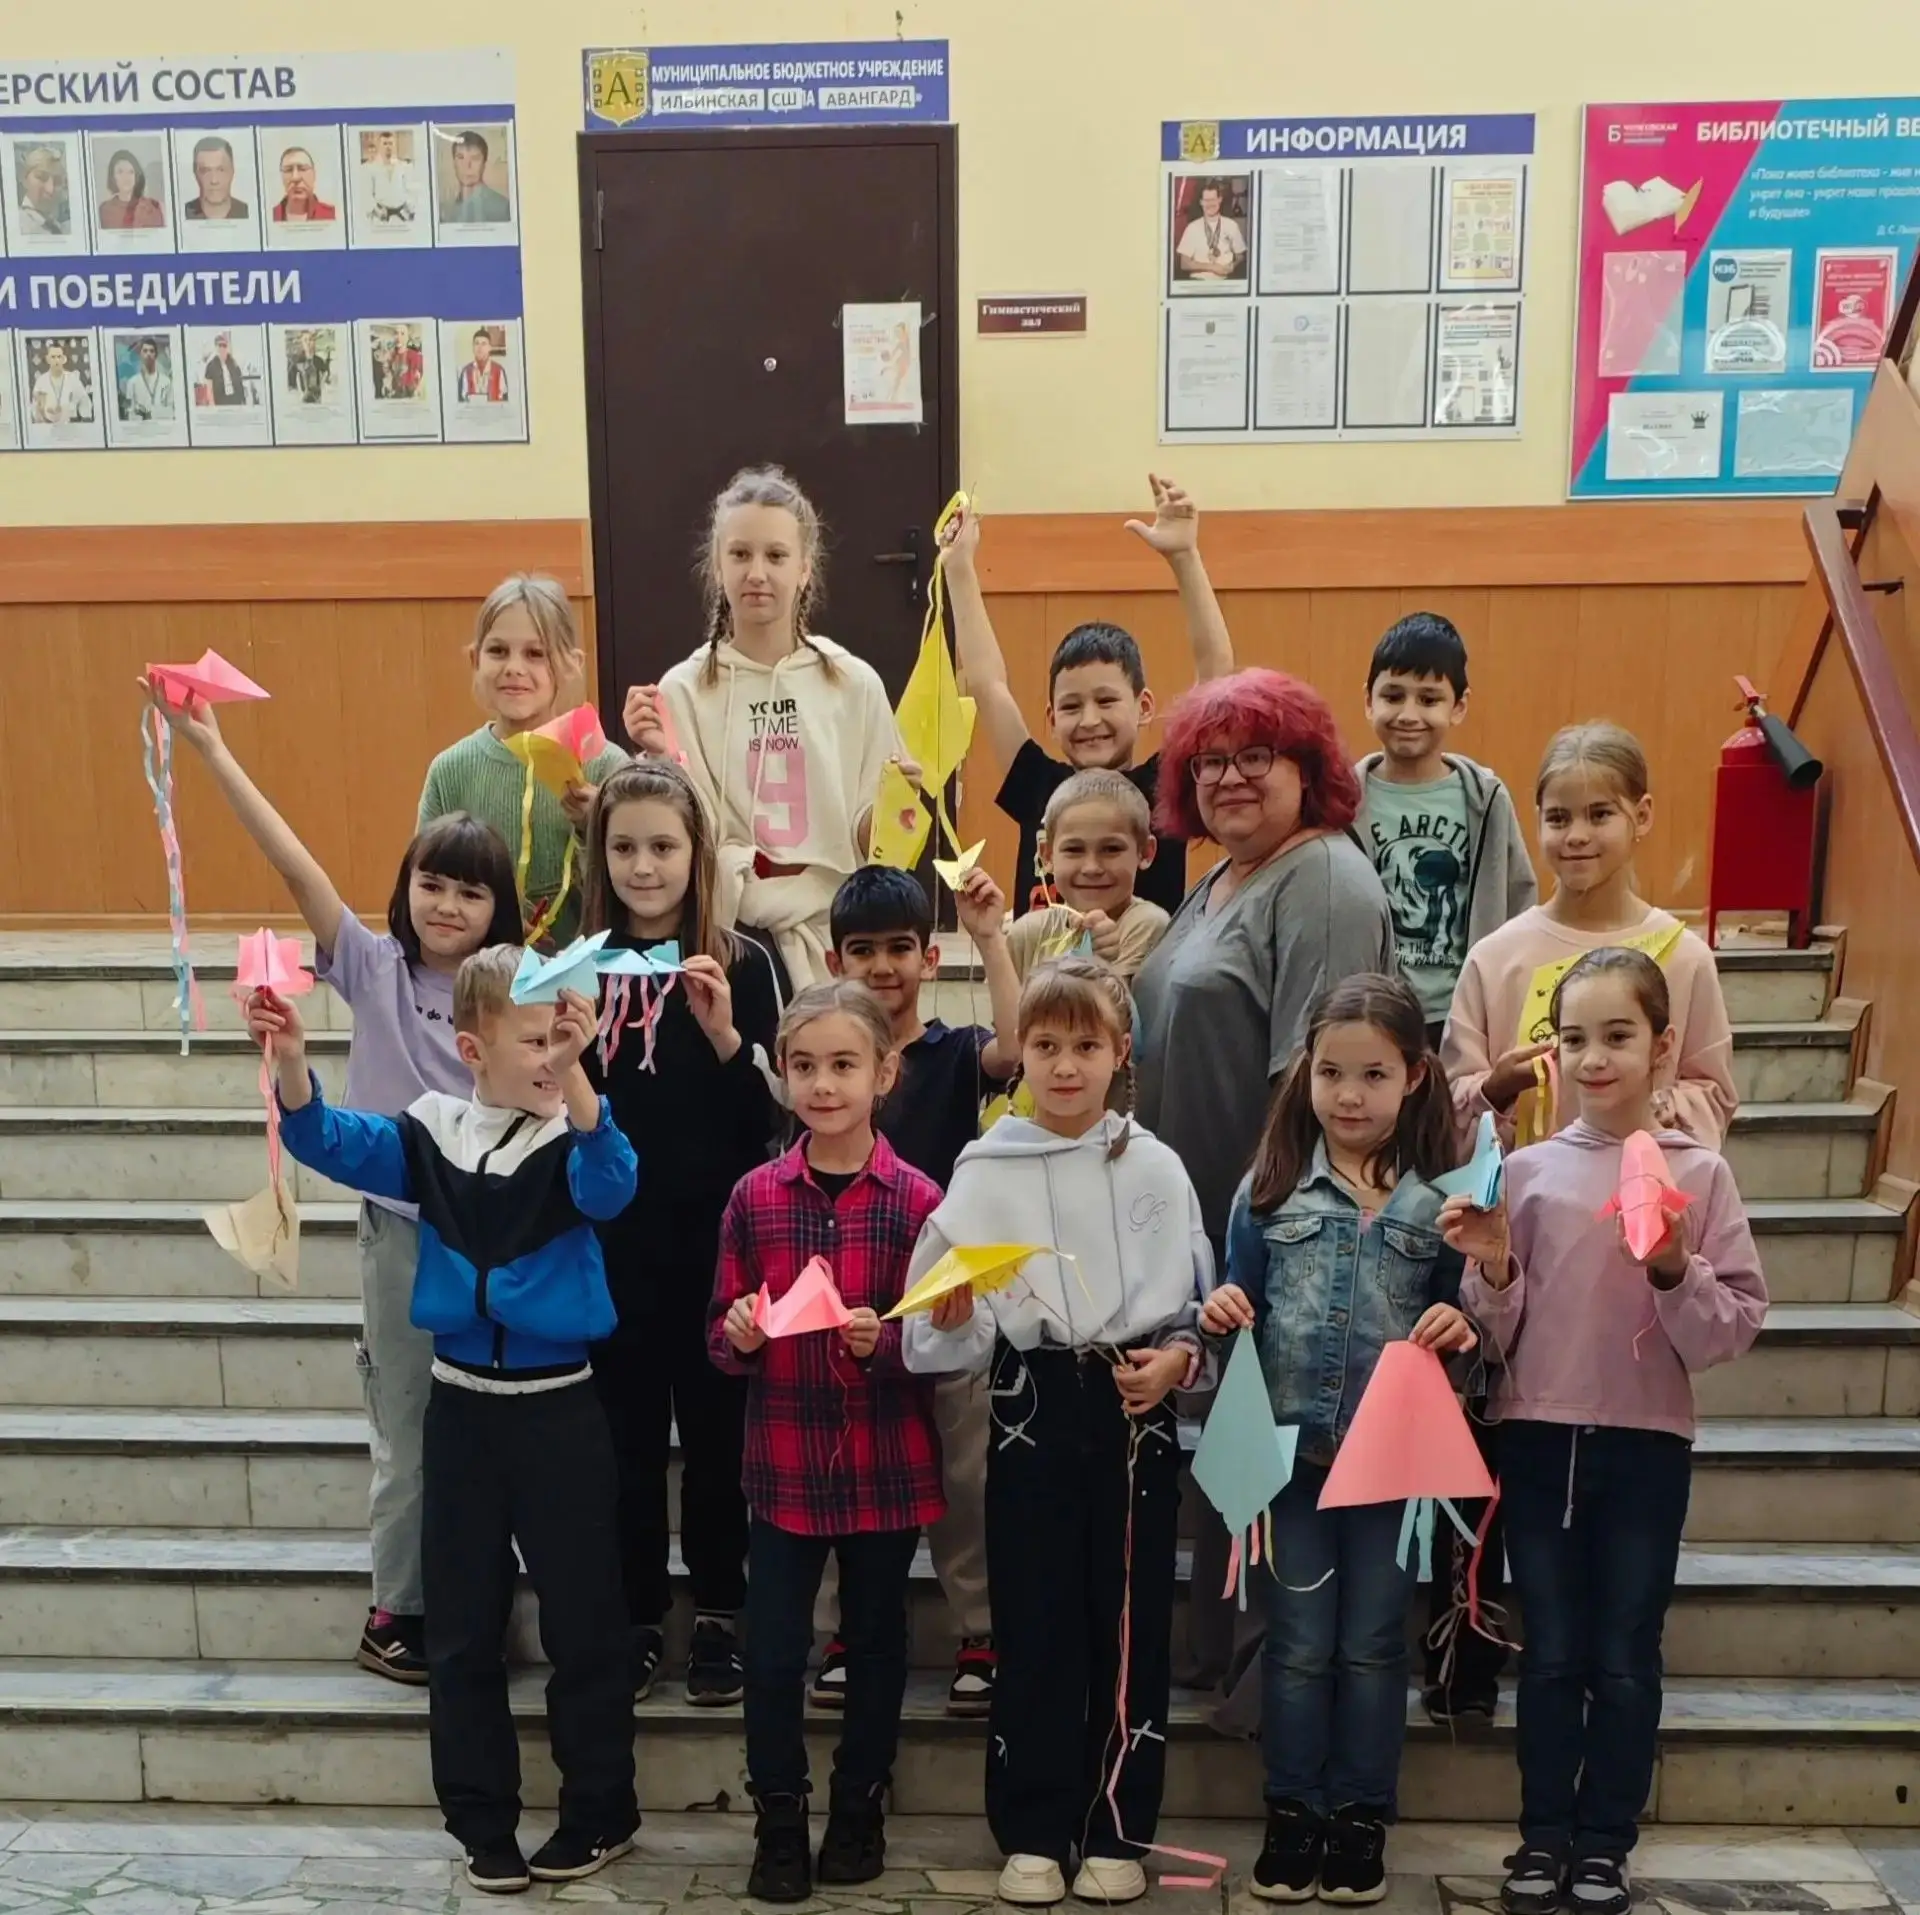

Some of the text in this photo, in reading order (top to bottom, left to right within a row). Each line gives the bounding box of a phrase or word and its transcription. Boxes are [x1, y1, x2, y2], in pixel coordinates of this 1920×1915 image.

[152, 66, 297, 102] СОСТАВ
[651, 58, 945, 86] МУНИЦИПАЛЬНОЕ БЮДЖЕТНОЕ УЧРЕЖДЕНИЕ
[661, 93, 759, 109] ИЛЬИНСКАЯ
[771, 92, 797, 107] СШ
[826, 89, 913, 108] АВАНГАРД
[1697, 112, 1920, 143] БИБЛИОТЕЧНЫЙ ВЕ
[1246, 124, 1467, 156] ИНФОРМАЦИЯ
[30, 269, 302, 315] ПОБЕДИТЕЛИ
[982, 302, 1081, 316] Гимнастический
[1021, 318, 1042, 328] зал
[749, 699, 797, 716] YOUR
[749, 715, 798, 736] TIME
[749, 737, 799, 752] IS NOW
[746, 737, 809, 848] 9
